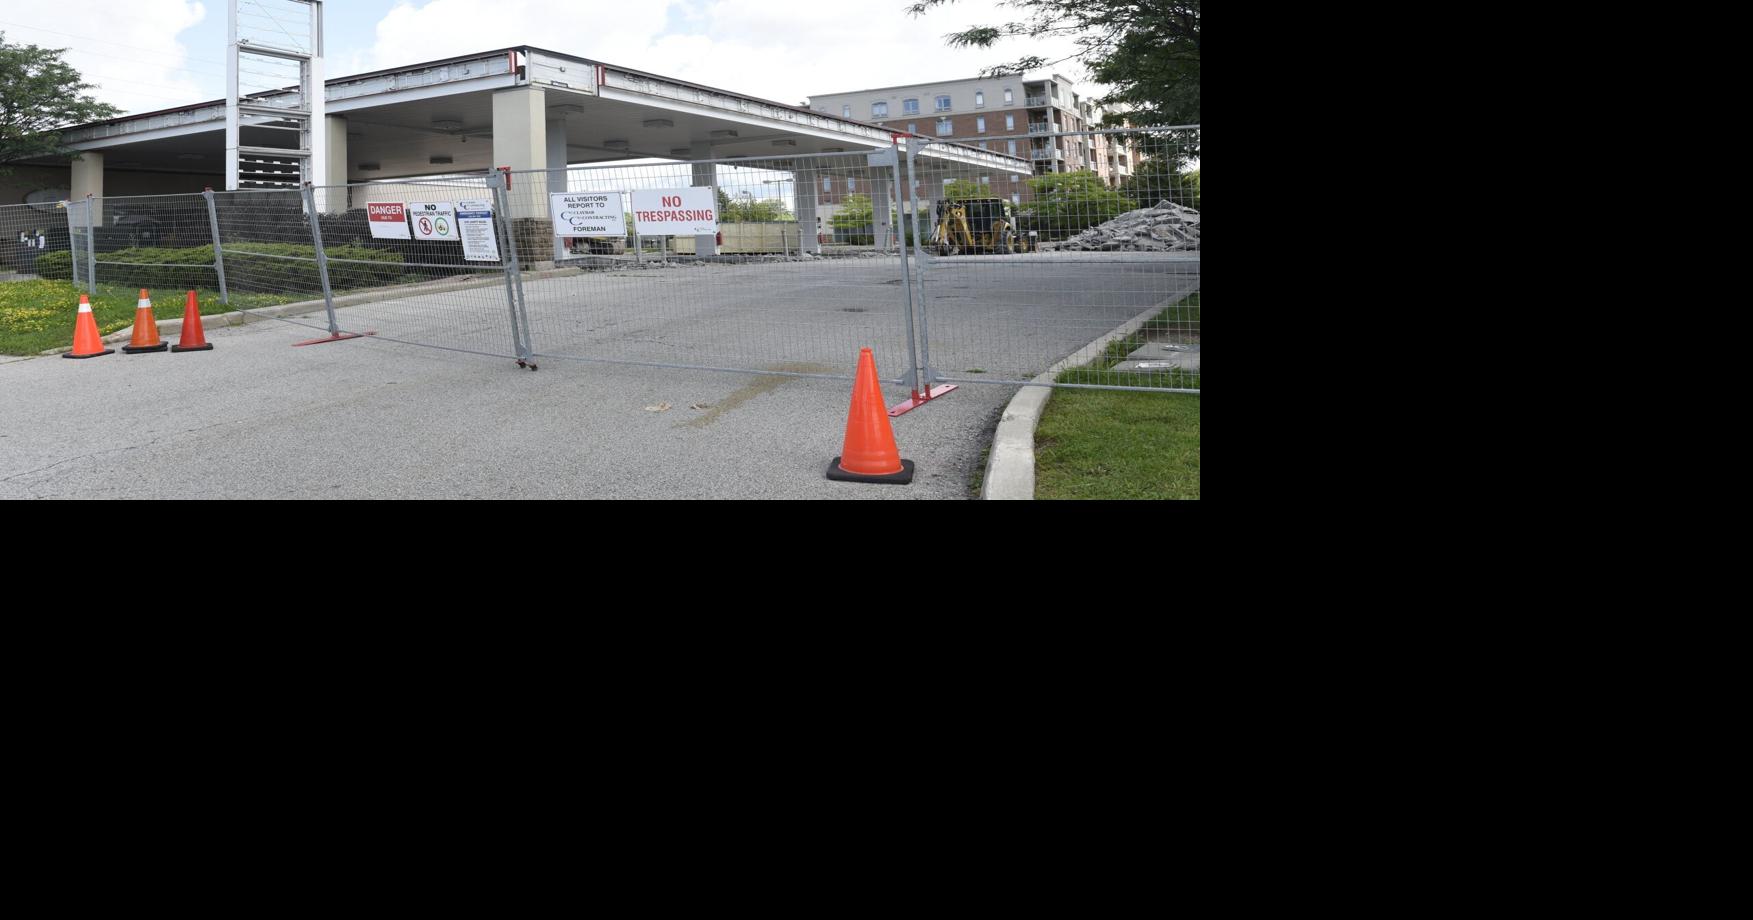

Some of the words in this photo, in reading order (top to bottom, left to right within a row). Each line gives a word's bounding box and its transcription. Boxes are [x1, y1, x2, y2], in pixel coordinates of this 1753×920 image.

[662, 196, 681, 207] NO
[370, 205, 402, 215] DANGER
[636, 210, 713, 222] TRESPASSING
